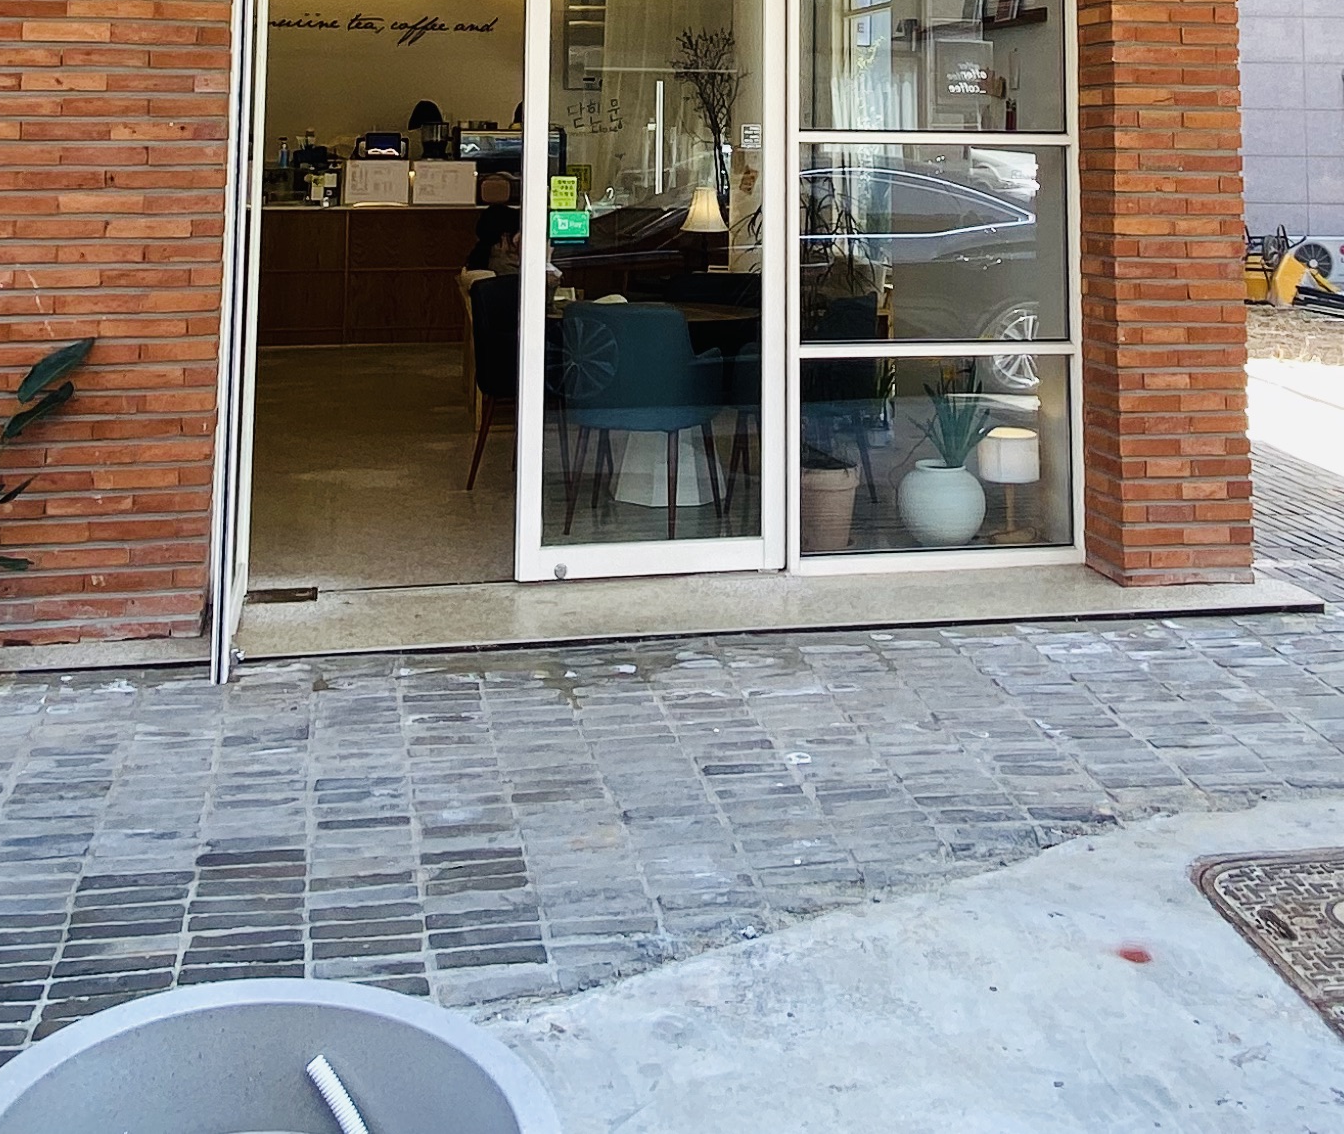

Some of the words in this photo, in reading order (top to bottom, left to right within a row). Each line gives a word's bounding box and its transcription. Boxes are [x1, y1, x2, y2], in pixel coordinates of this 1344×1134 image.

[348, 13, 385, 33] tea,
[390, 16, 449, 47] coffee
[454, 17, 498, 32] and
[567, 99, 603, 129] 닫힌
